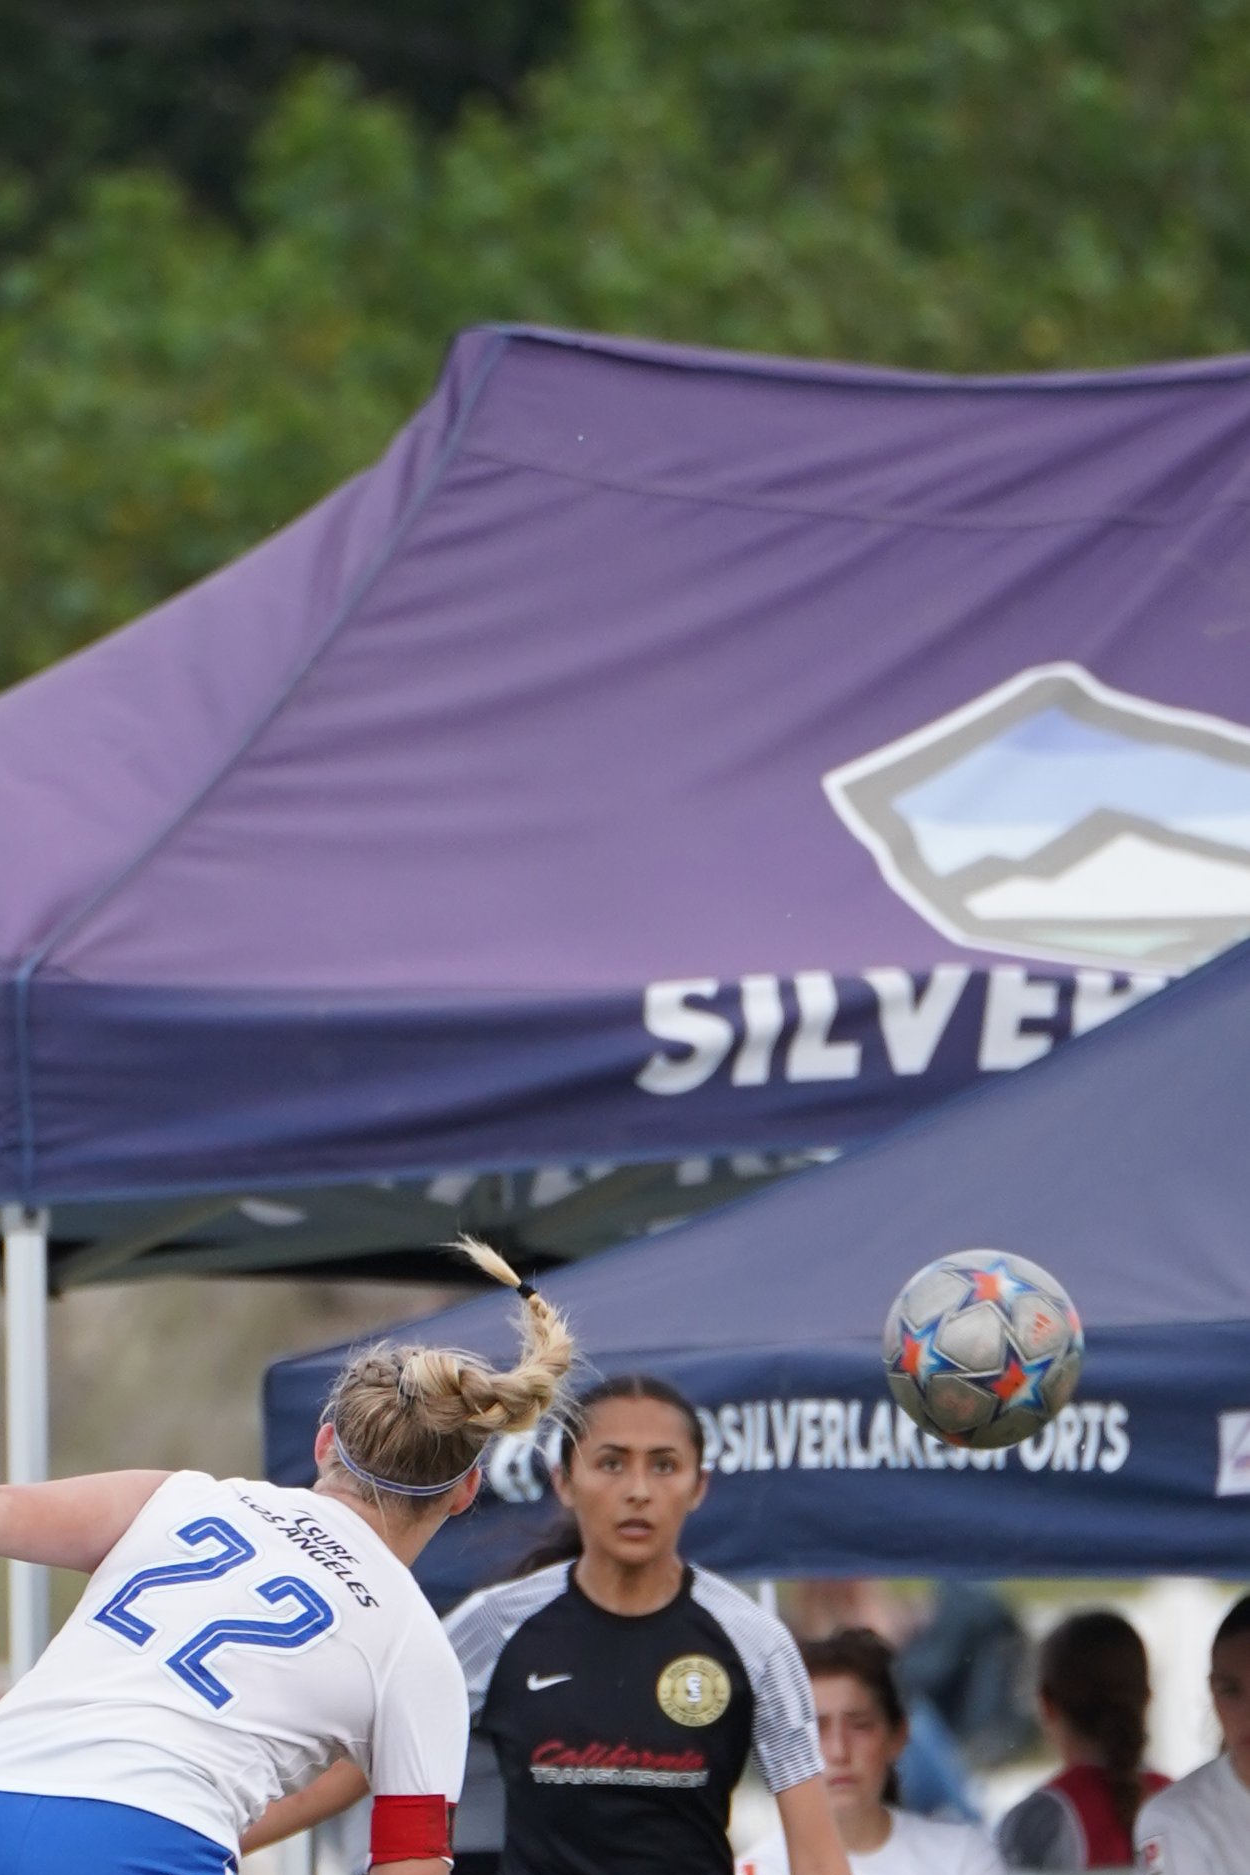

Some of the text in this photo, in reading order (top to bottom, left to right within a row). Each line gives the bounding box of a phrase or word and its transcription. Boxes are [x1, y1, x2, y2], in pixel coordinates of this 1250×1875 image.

[699, 1398, 1131, 1474] SILVERLAKORTS
[240, 1496, 381, 1609] LOS ANGELES
[307, 1526, 361, 1565] SURF
[94, 1516, 336, 1710] 22
[529, 1766, 708, 1789] TRANSMISSION
